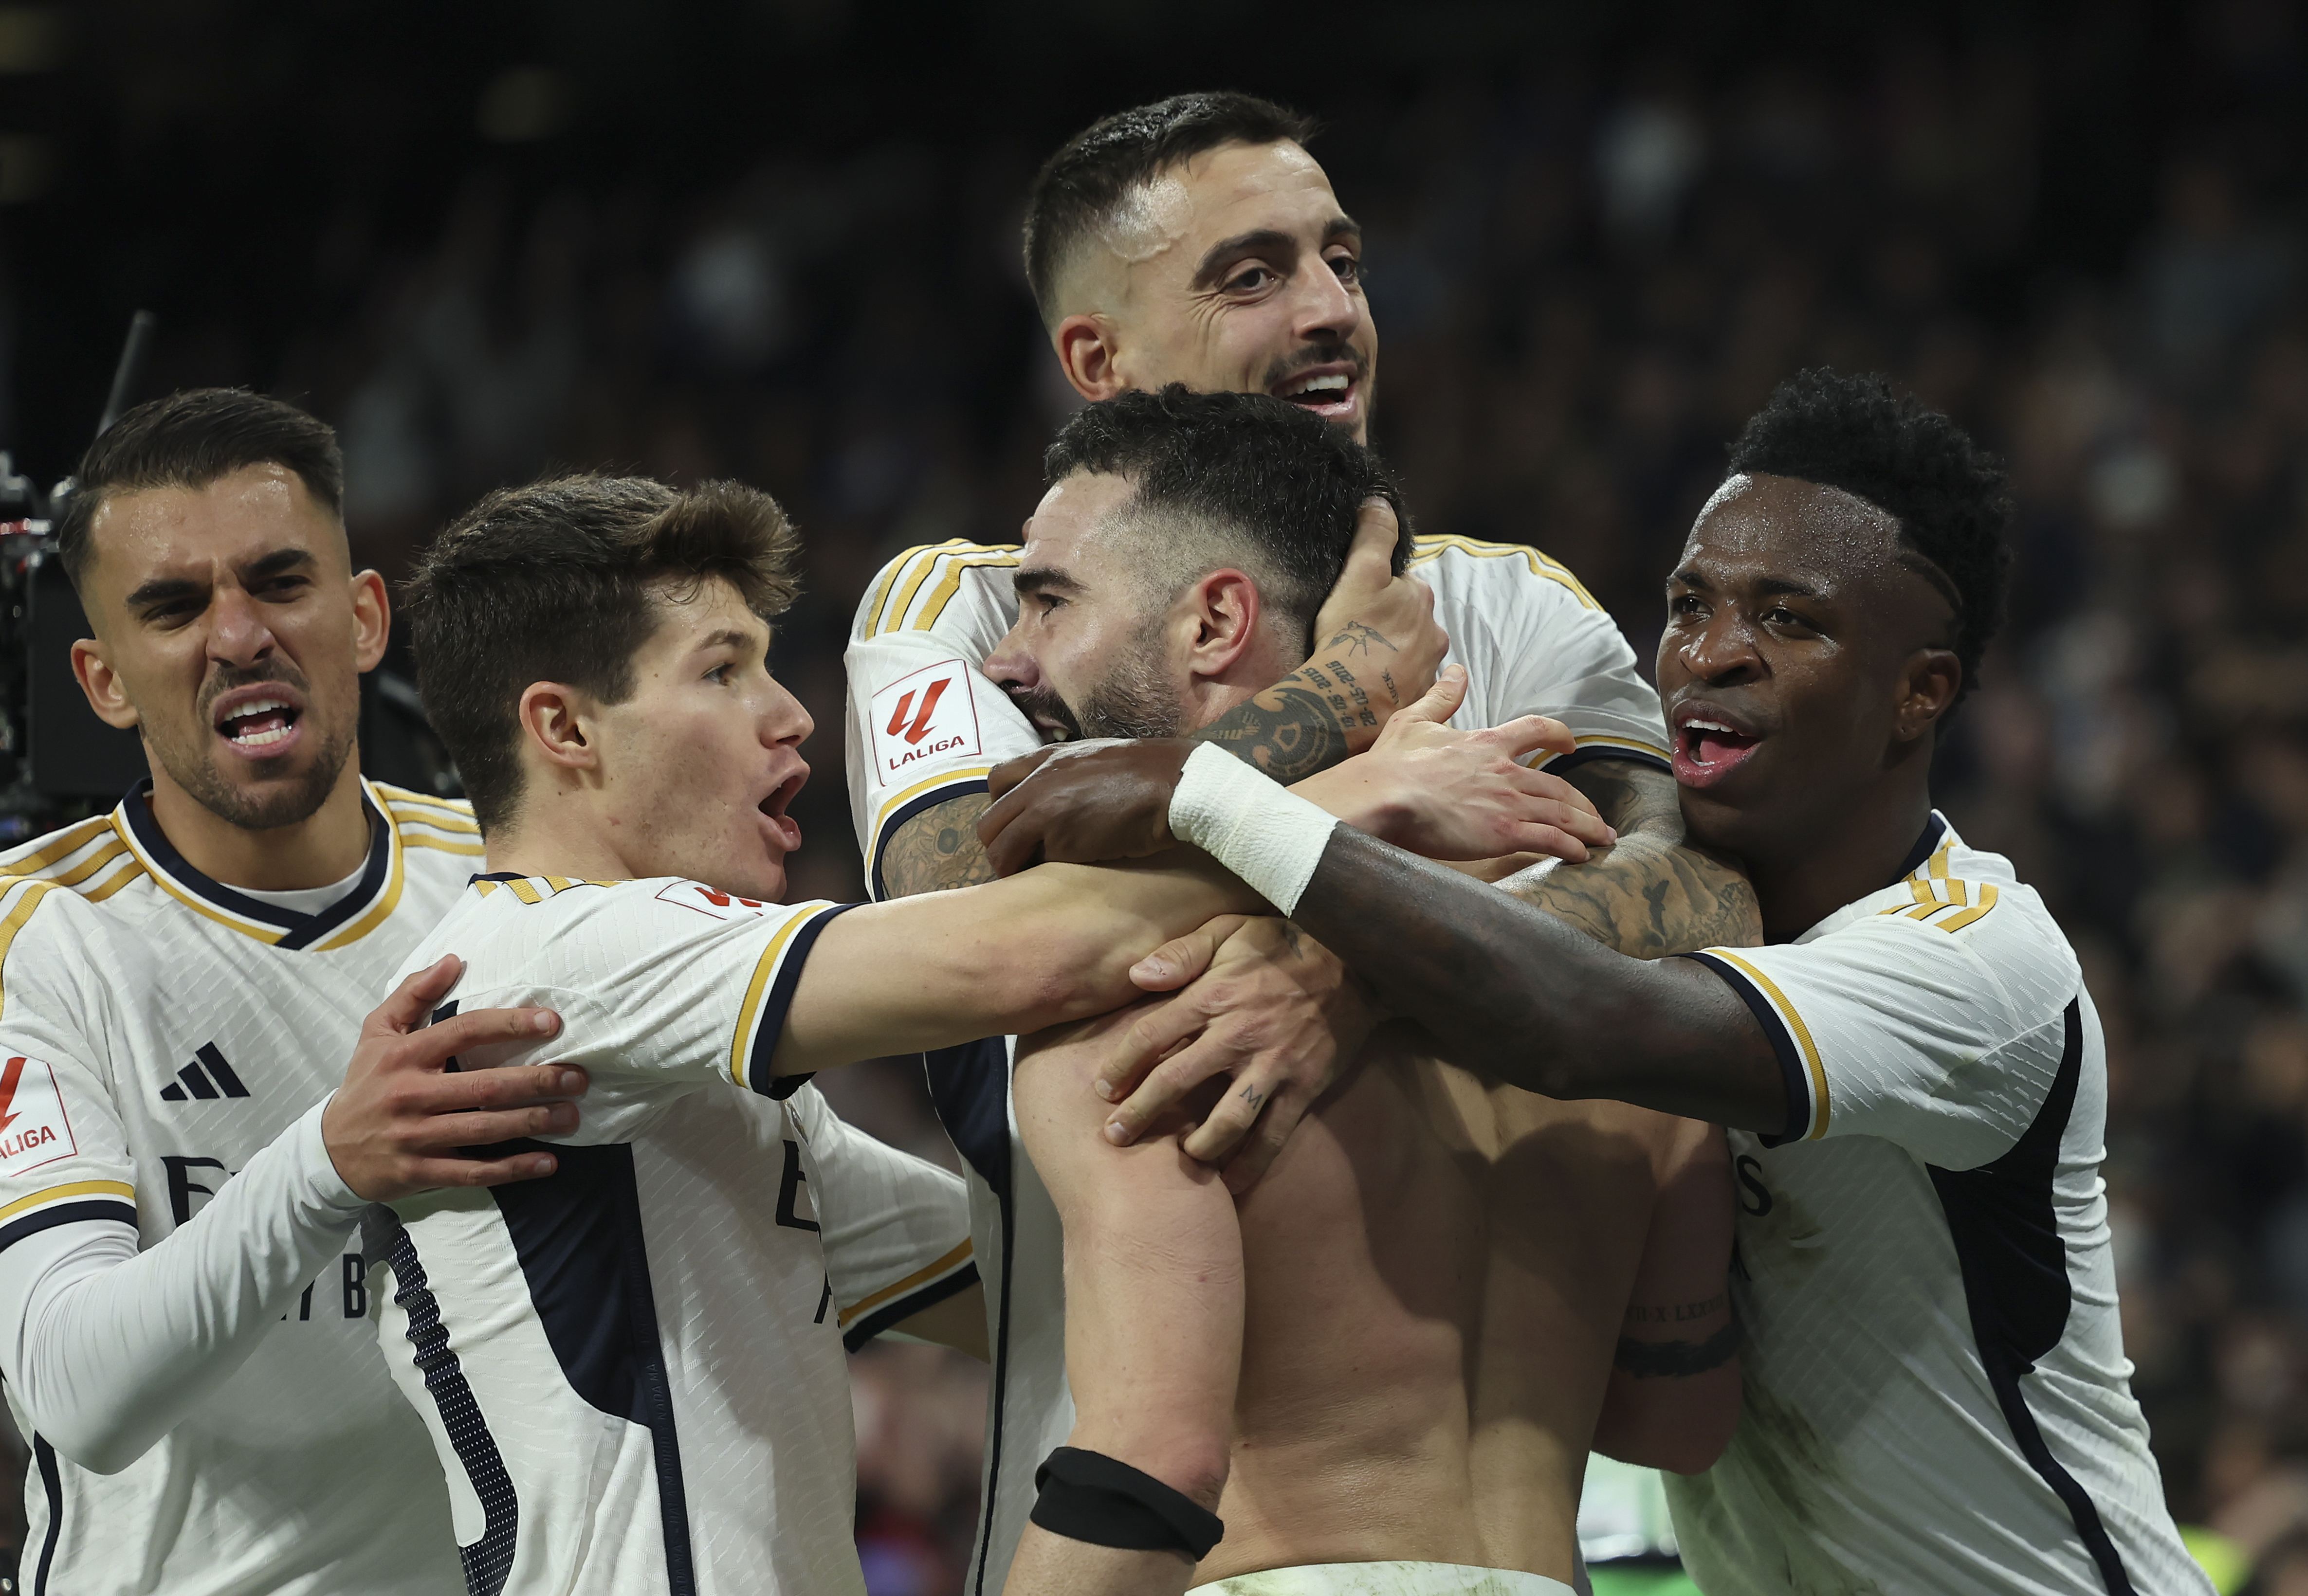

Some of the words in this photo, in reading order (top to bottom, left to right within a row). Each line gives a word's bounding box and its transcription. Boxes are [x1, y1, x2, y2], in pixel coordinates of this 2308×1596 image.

[889, 735, 965, 770] LALIGA
[1239, 1084, 1263, 1110] M
[0, 1124, 56, 1161] ALIGA
